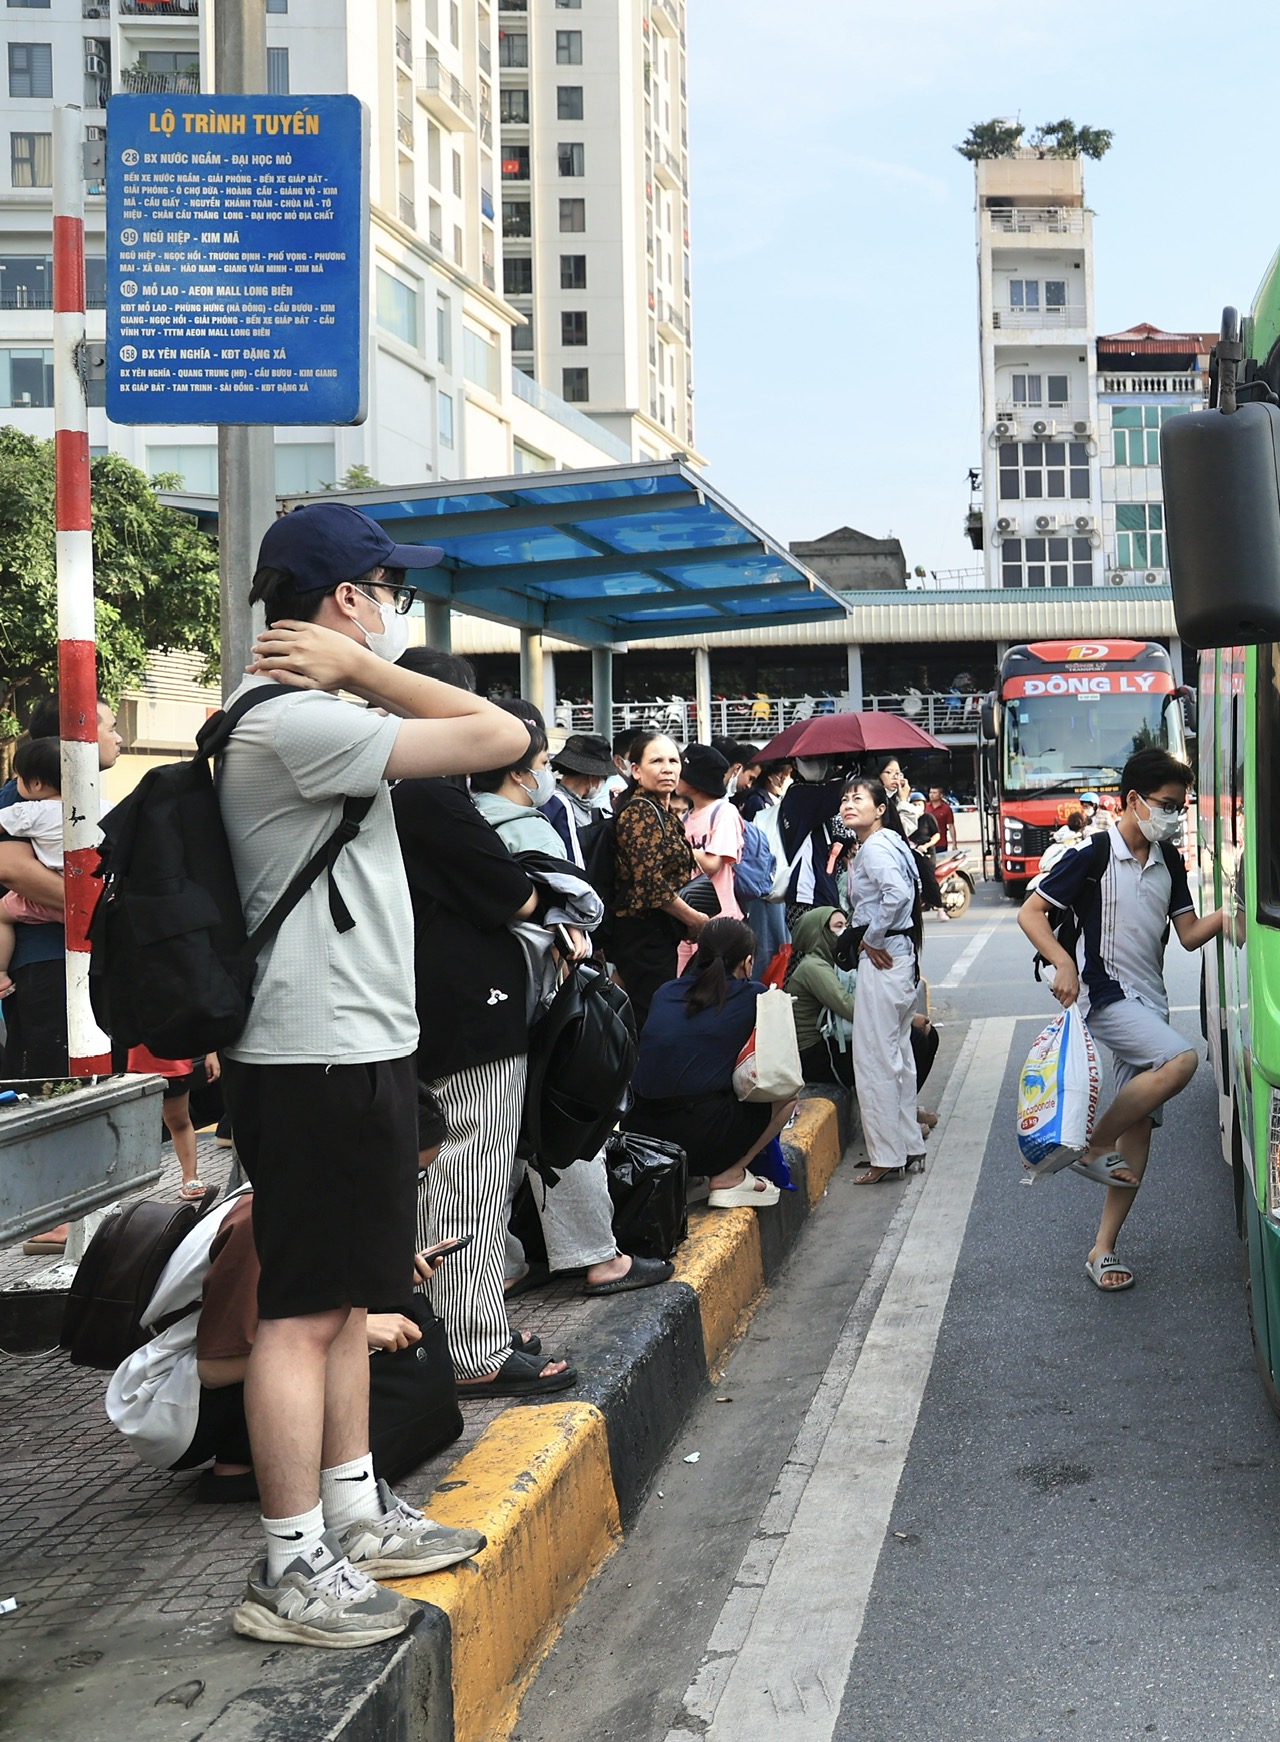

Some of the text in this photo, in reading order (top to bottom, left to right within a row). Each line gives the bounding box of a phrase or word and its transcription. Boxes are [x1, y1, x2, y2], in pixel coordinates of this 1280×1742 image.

[149, 108, 318, 137] LỘ TRÌNH TUYẾN
[125, 153, 138, 163] 28
[143, 155, 157, 164] BX
[230, 152, 248, 166] ĐẠI
[251, 152, 272, 166] HỌC
[275, 152, 292, 165] MỎ
[123, 230, 239, 245] 99 NGŨ HIỆP KIM MÃ
[122, 284, 136, 295] 106
[159, 285, 178, 296] LAO
[187, 285, 214, 296] AEON
[215, 285, 241, 296] MALL
[243, 285, 268, 296] LONG
[270, 284, 292, 296] BIÊN
[121, 347, 286, 361] 158 BX YÊN NGHĨA KĐT ĐẶNG XÁ
[1023, 672, 1155, 695] ĐÔNG LÝ
